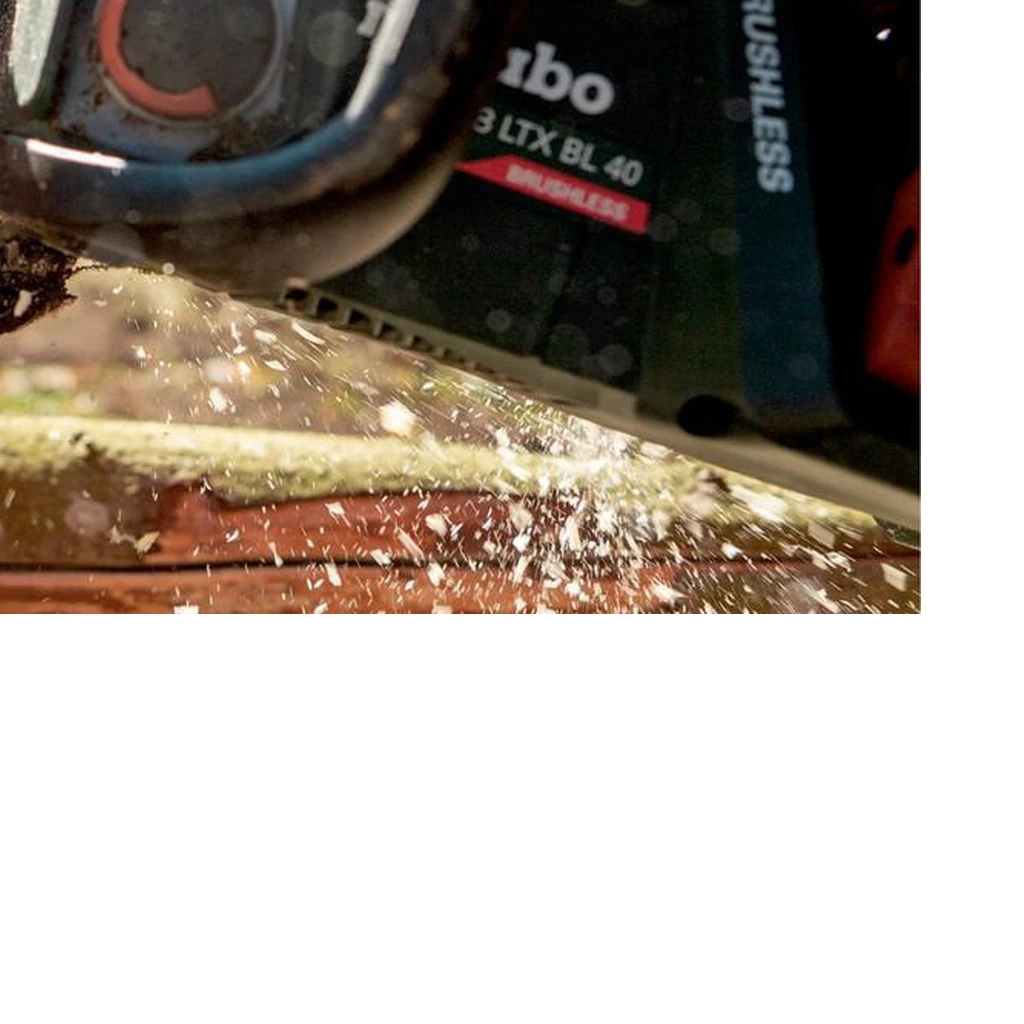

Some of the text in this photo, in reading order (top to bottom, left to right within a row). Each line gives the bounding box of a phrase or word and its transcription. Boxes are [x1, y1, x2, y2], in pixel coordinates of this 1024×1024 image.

[497, 114, 558, 158] LTX
[559, 136, 598, 174] BL
[603, 155, 644, 187] 40
[504, 163, 630, 222] BRUSHLESS
